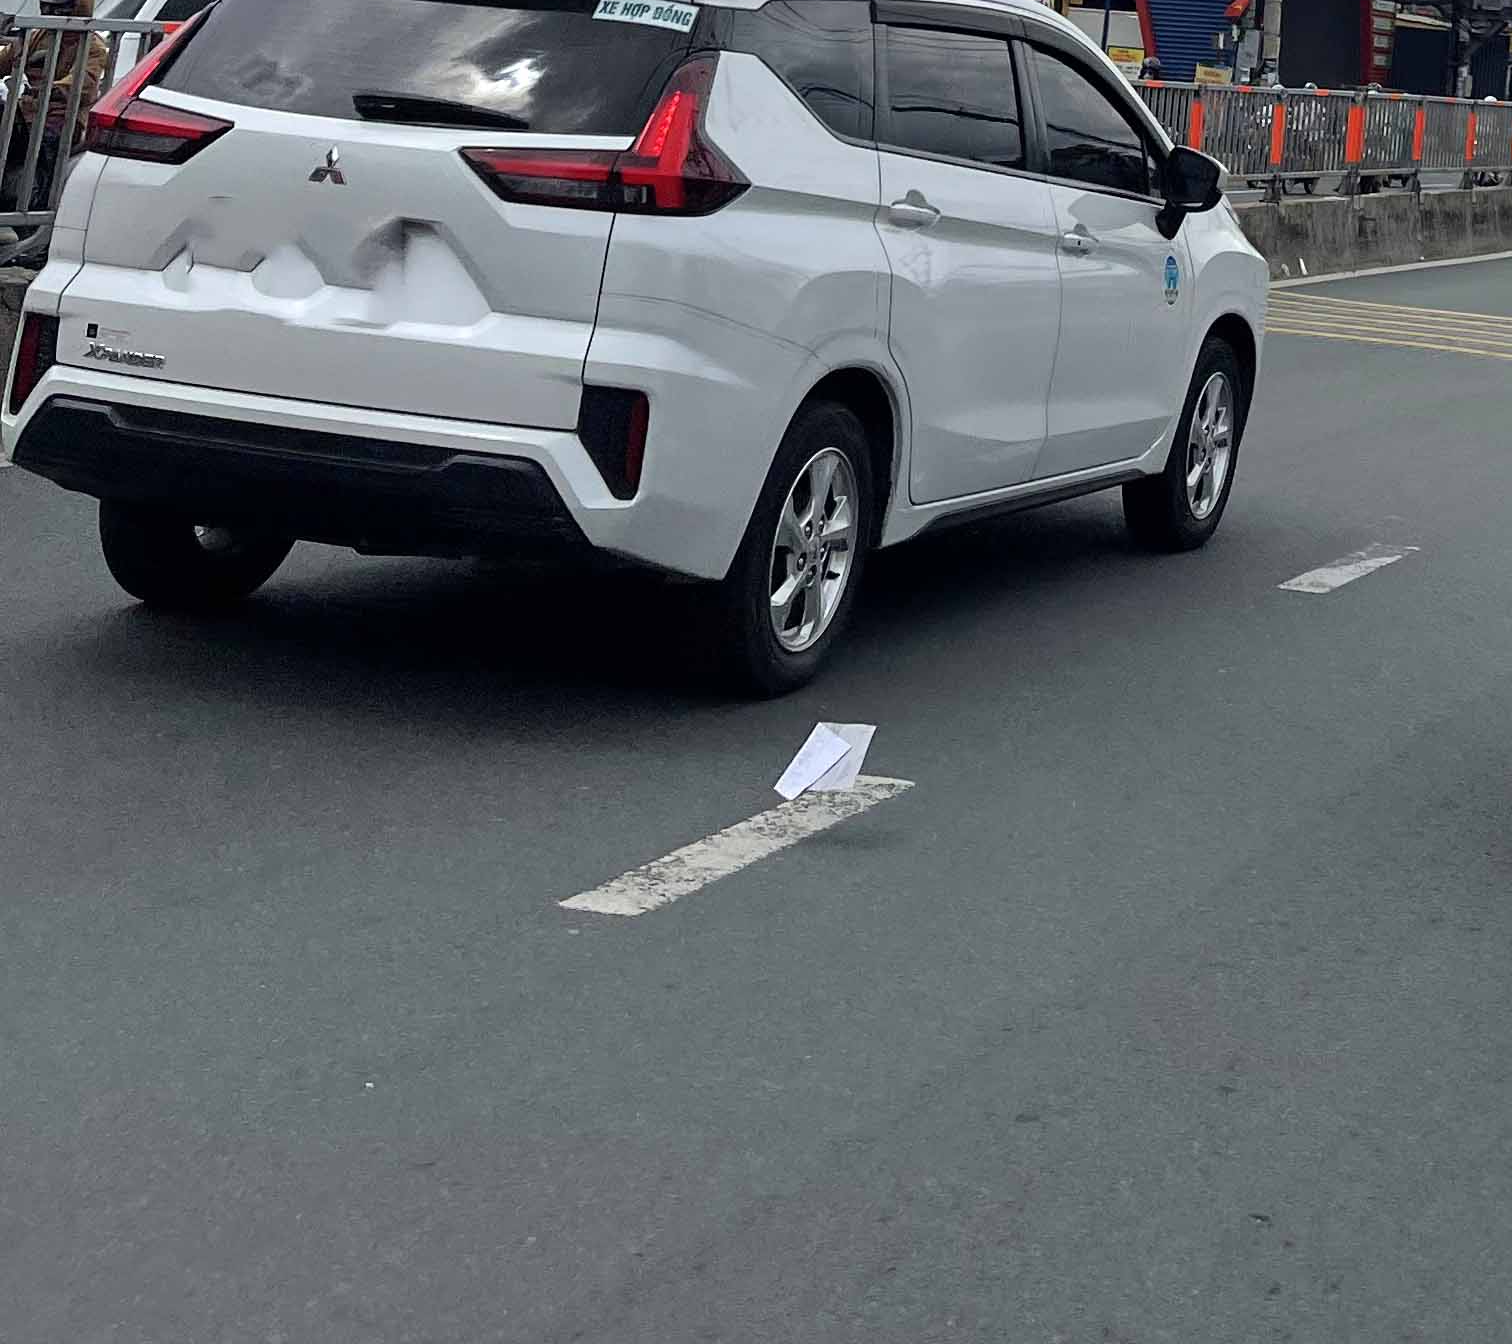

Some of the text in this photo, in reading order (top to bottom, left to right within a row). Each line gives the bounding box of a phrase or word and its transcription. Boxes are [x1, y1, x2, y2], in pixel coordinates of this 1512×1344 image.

[599, 0, 693, 27] XE HỢP ĐỒNG
